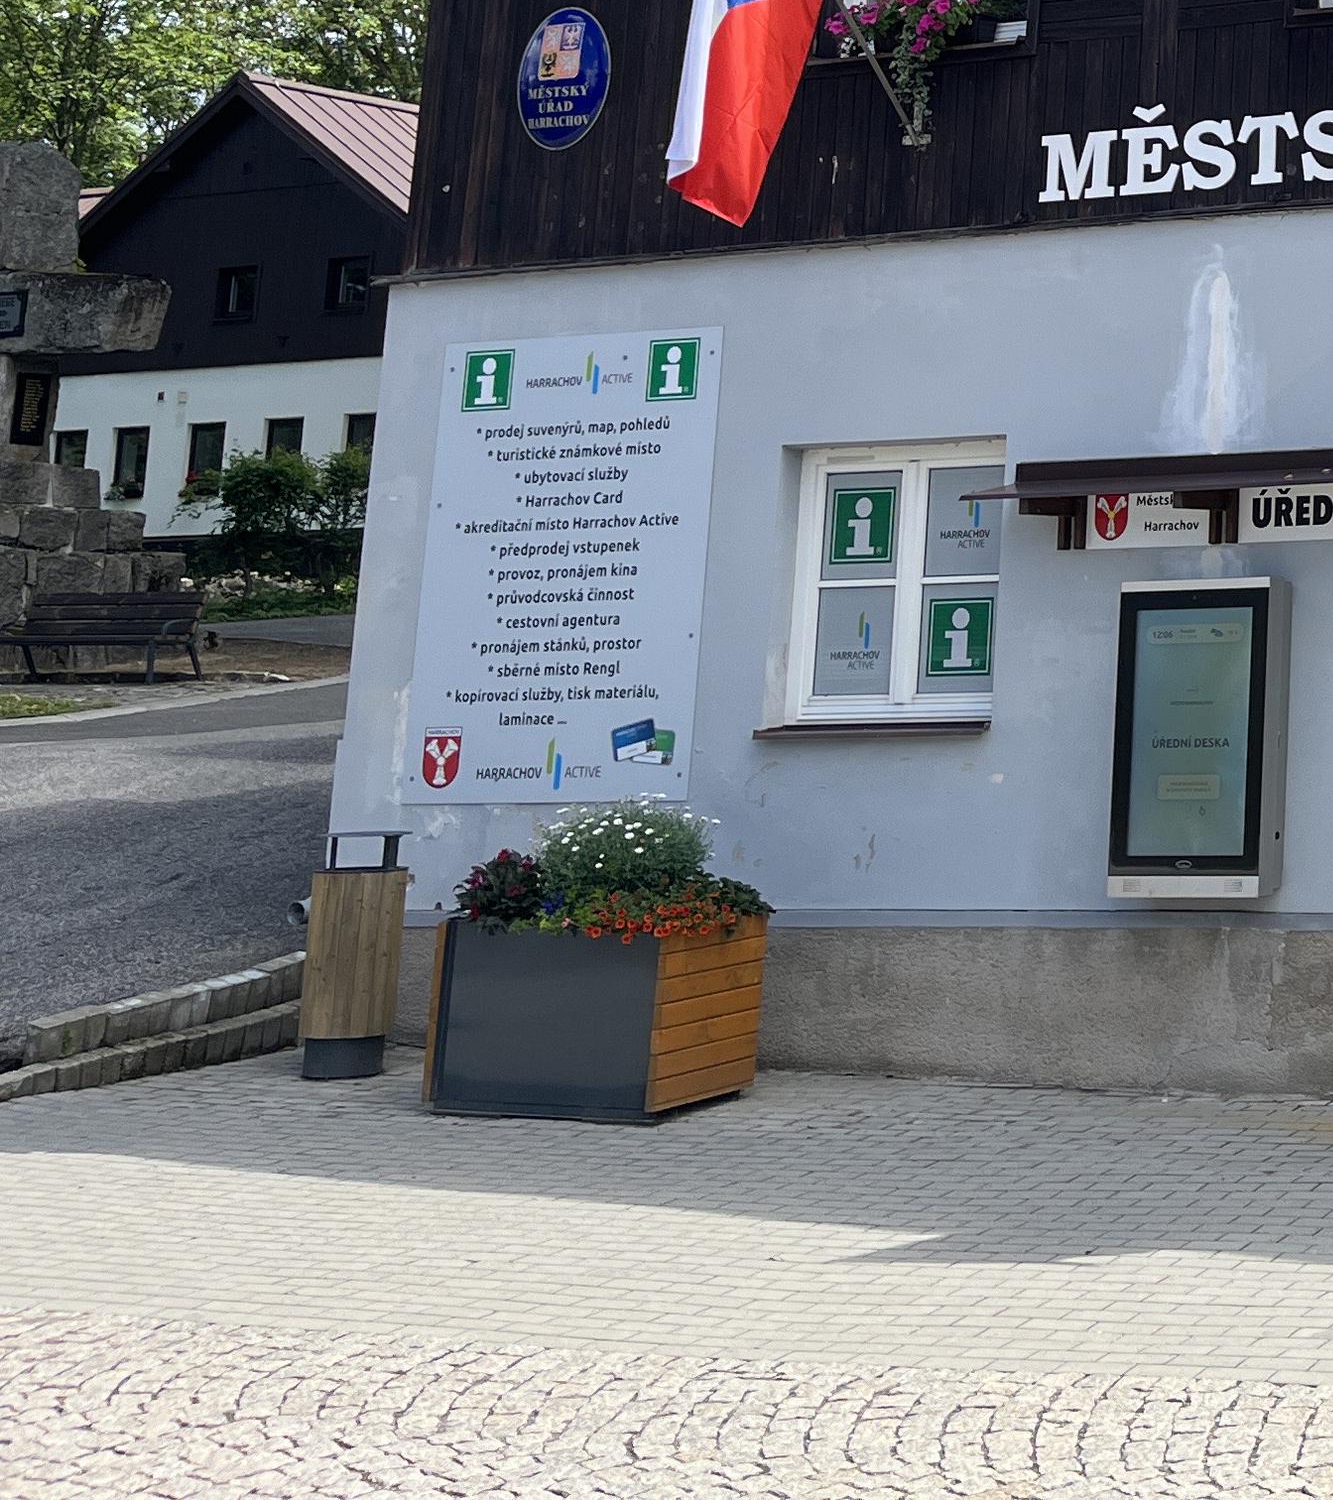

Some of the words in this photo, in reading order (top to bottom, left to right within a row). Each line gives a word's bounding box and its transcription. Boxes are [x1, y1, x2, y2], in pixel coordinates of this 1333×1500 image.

[527, 83, 590, 100] MĚSTSKÝ
[538, 99, 574, 113] ÚŘAD
[527, 115, 589, 129] HARRACHOV
[526, 376, 583, 388] HARRACHOV
[601, 372, 633, 385] ACTIVE
[485, 424, 524, 442] prodej
[527, 420, 585, 438] suvenýrů,
[588, 423, 617, 435] map,
[620, 415, 670, 434] pohledů
[497, 446, 556, 462] turistické
[559, 442, 622, 459] známkové
[626, 441, 661, 455] místo
[524, 468, 586, 486] ubytovací
[588, 466, 628, 482] služby
[525, 492, 590, 508] Harrachov
[593, 490, 623, 504] Card
[464, 518, 533, 534] akreditační
[535, 517, 569, 531] místo
[573, 514, 637, 529] Harrachov
[638, 512, 679, 526] Active
[1144, 519, 1199, 531] Harrachov
[940, 529, 991, 539] HARRACHOV
[499, 540, 570, 560] předprodej
[573, 537, 640, 556] vstupenek
[957, 538, 985, 549] ACTIVE
[497, 569, 544, 583] provoz,
[547, 564, 607, 582] pronájem
[611, 563, 637, 576] kina
[496, 588, 583, 608] průvodcovská
[587, 587, 635, 601] činnost
[506, 613, 559, 629] cestovní
[562, 614, 620, 630] agentura
[480, 639, 540, 657] pronájem
[543, 636, 590, 653] stánků,
[593, 637, 642, 653] prostor
[830, 650, 880, 660] HARRACHOV
[497, 662, 540, 678] sběrné
[544, 662, 580, 676] místo
[583, 660, 620, 677] Rengl
[846, 659, 875, 670] ACTIVE
[455, 687, 519, 705] kopírovací
[522, 687, 564, 703] služby,
[567, 686, 591, 700] tisk
[594, 684, 659, 700] materiálu,
[499, 712, 554, 726] laminace
[1151, 736, 1192, 749] ÚŘEDNÍ
[1193, 737, 1230, 748] DESKA
[476, 767, 542, 782] HARRACHOV
[564, 765, 602, 778] ACTIVE
